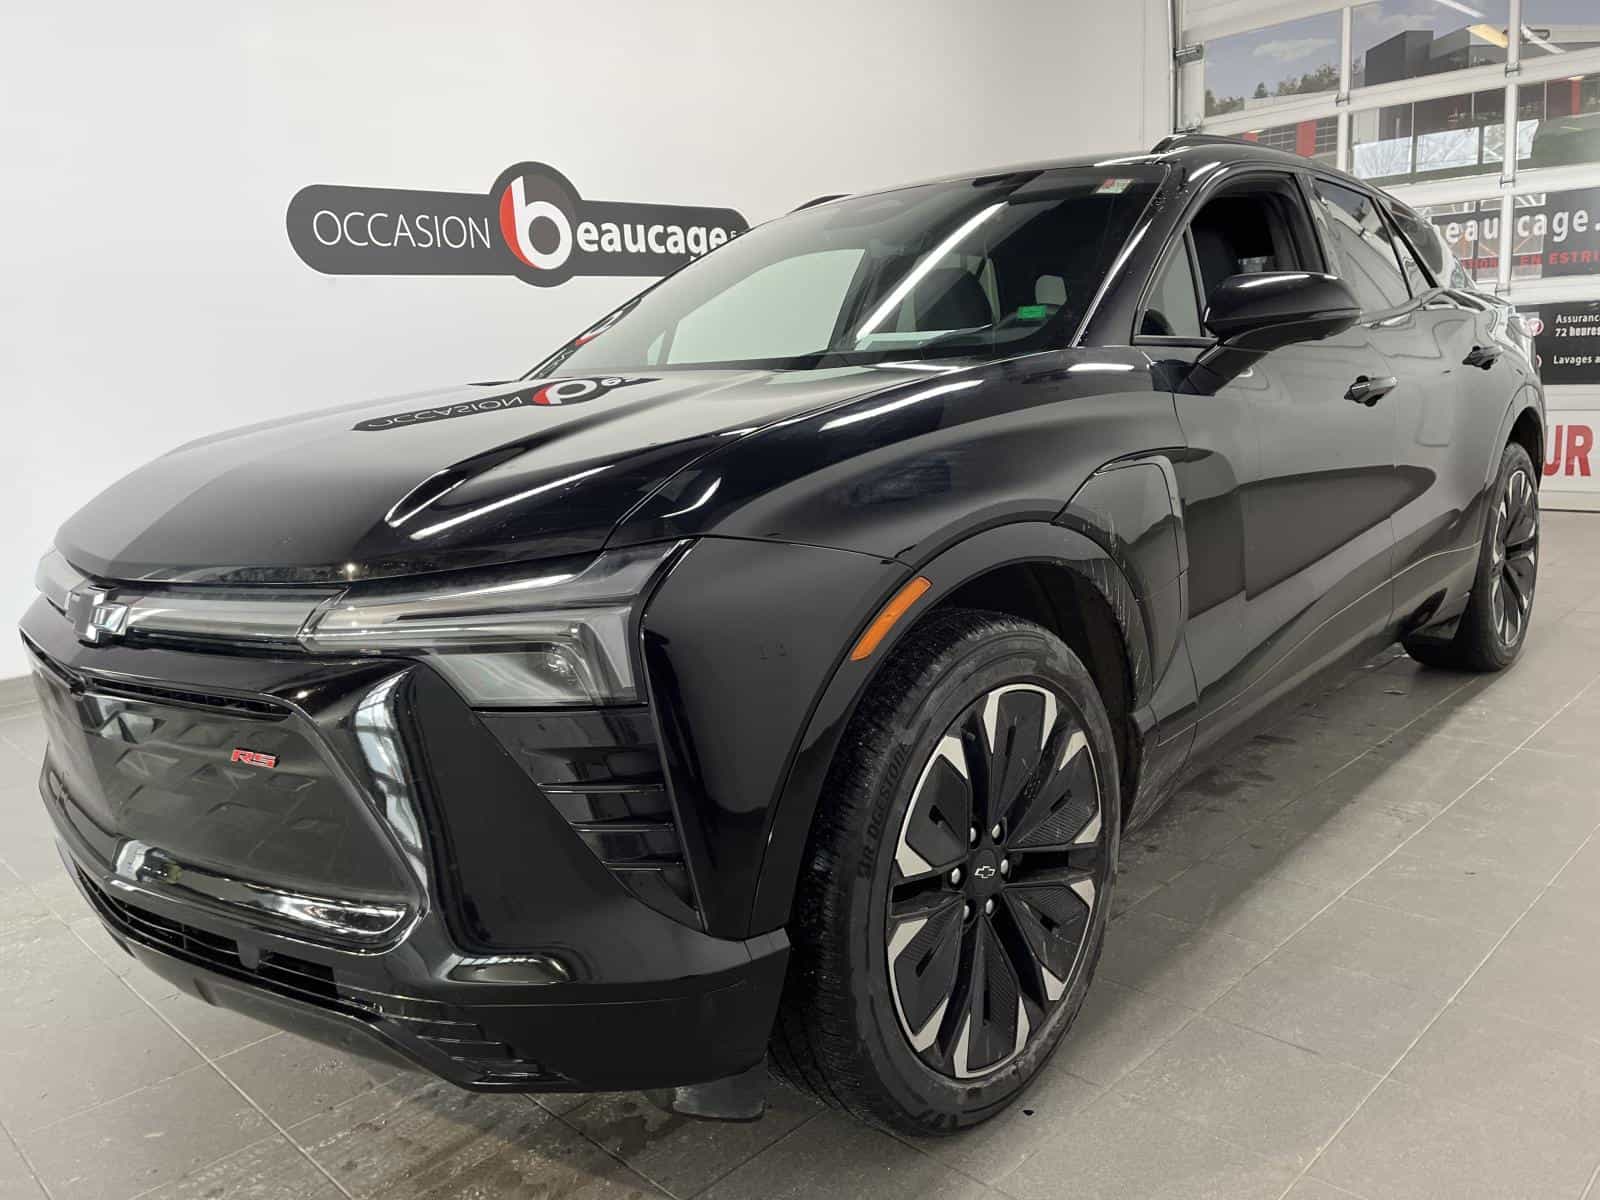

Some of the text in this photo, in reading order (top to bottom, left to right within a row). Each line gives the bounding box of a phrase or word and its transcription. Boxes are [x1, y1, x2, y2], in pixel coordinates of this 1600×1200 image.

[312, 209, 491, 250] OCCASION
[1555, 328, 1567, 337] 72
[1553, 355, 1592, 366] Lavages
[231, 748, 276, 768] RS
